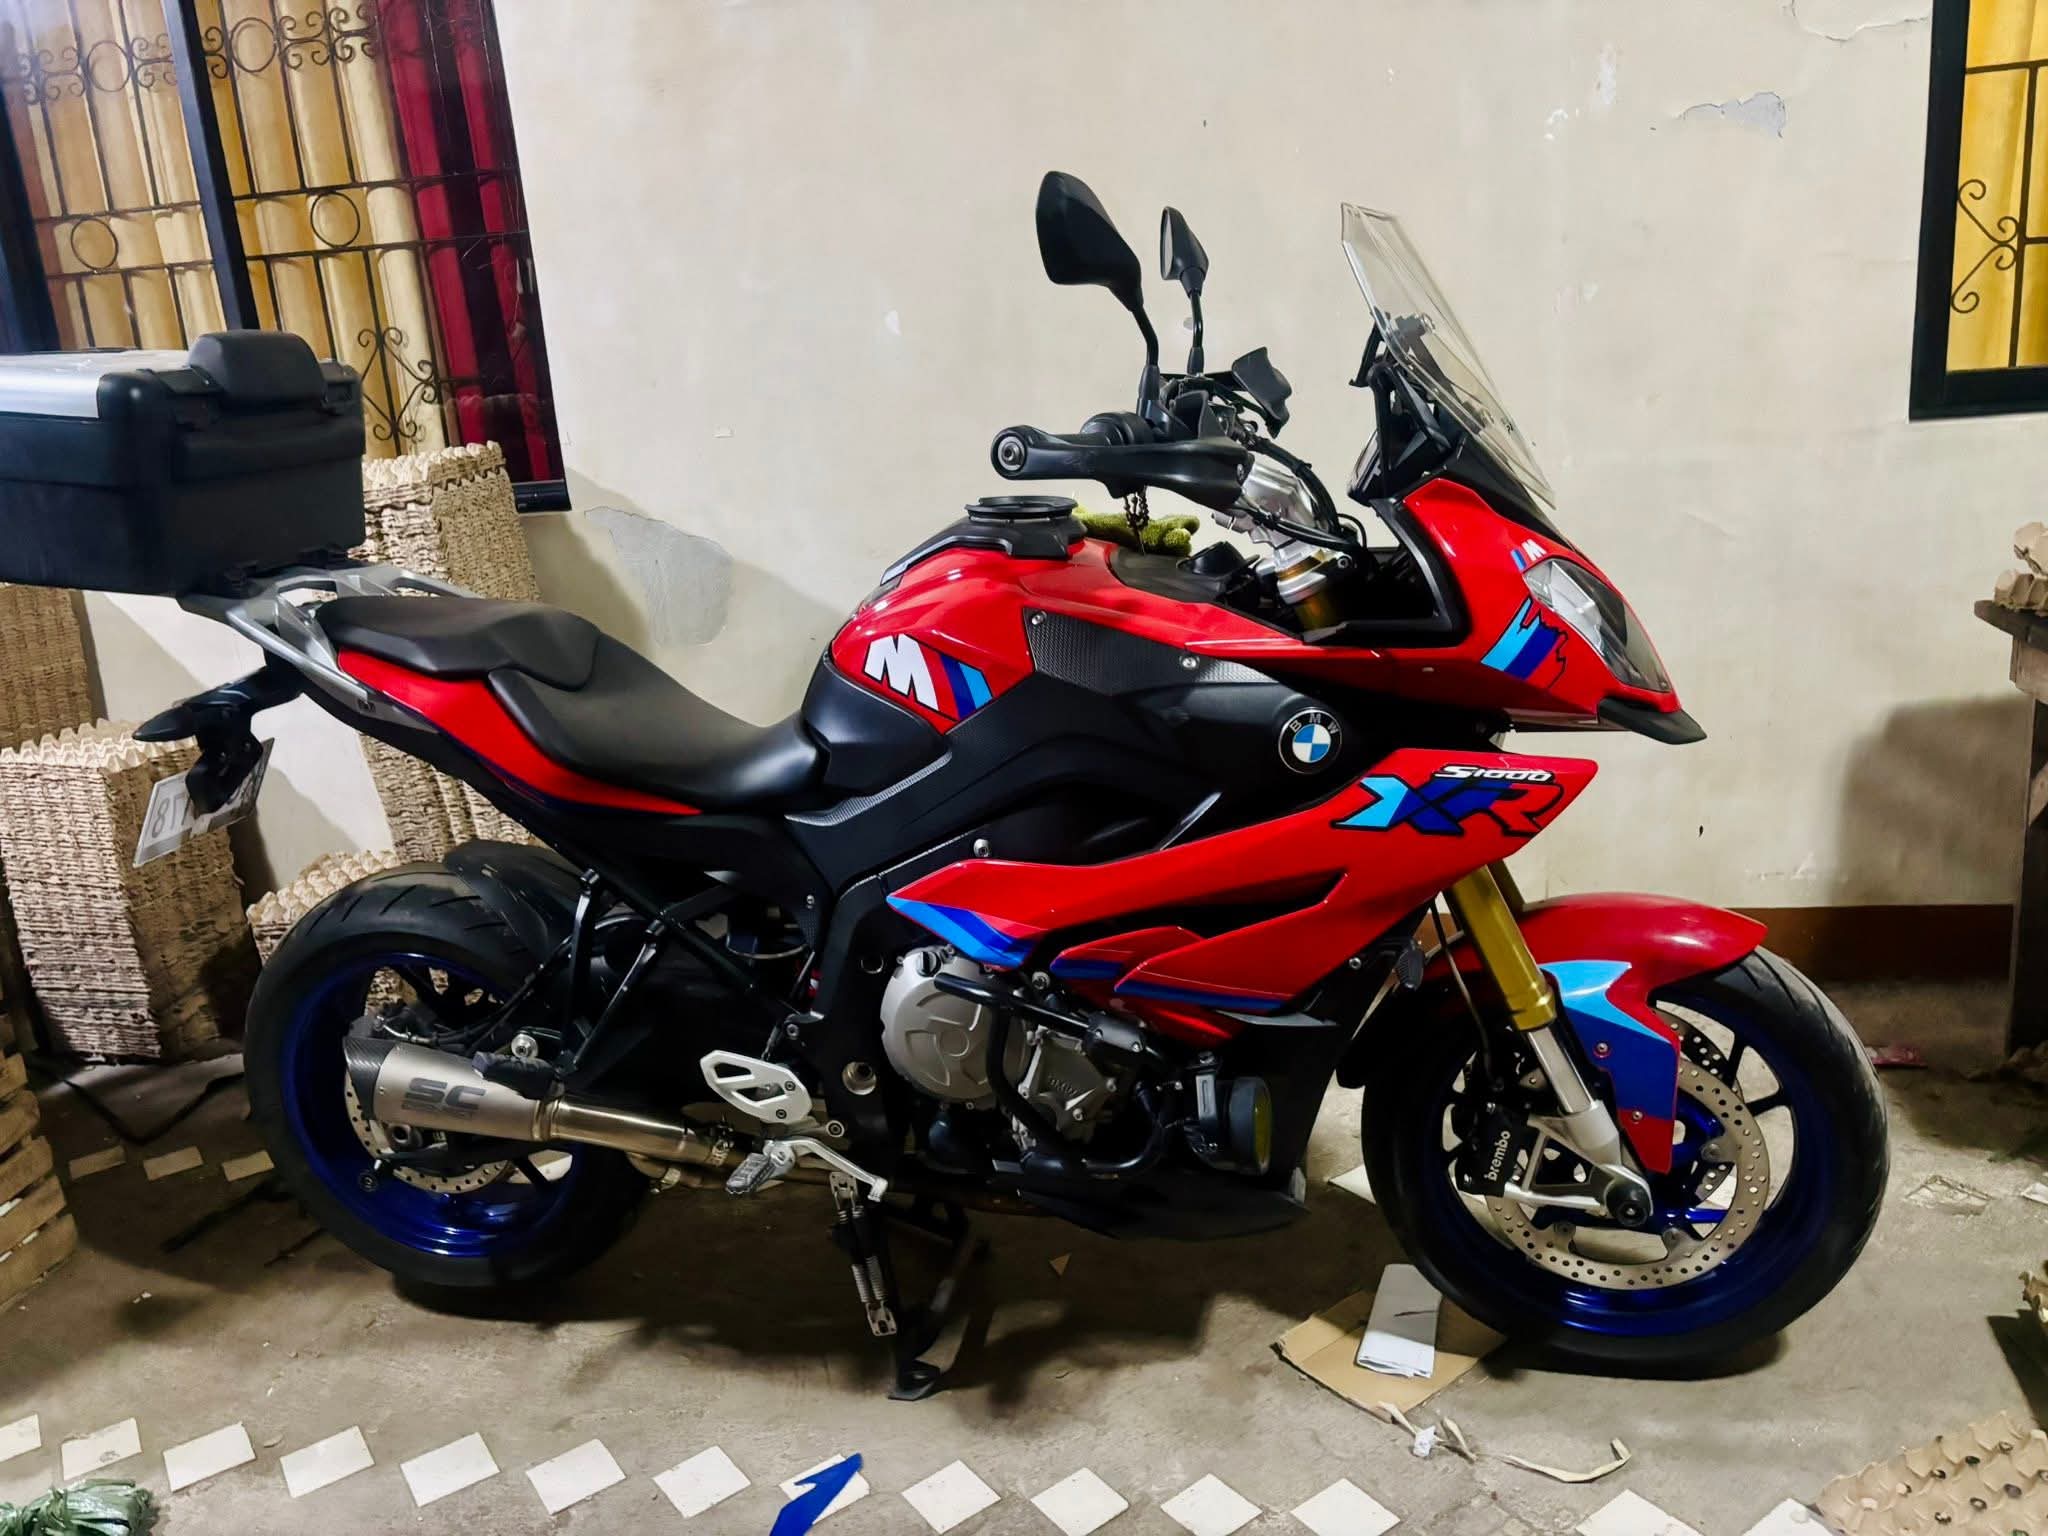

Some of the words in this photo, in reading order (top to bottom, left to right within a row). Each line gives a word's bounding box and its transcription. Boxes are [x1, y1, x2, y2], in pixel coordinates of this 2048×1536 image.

[863, 632, 940, 712] M
[1288, 711, 1340, 735] BMW
[1434, 765, 1554, 782] S1000
[1331, 774, 1564, 837] XR
[404, 1077, 486, 1110] SC
[1483, 1130, 1511, 1181] brembo
